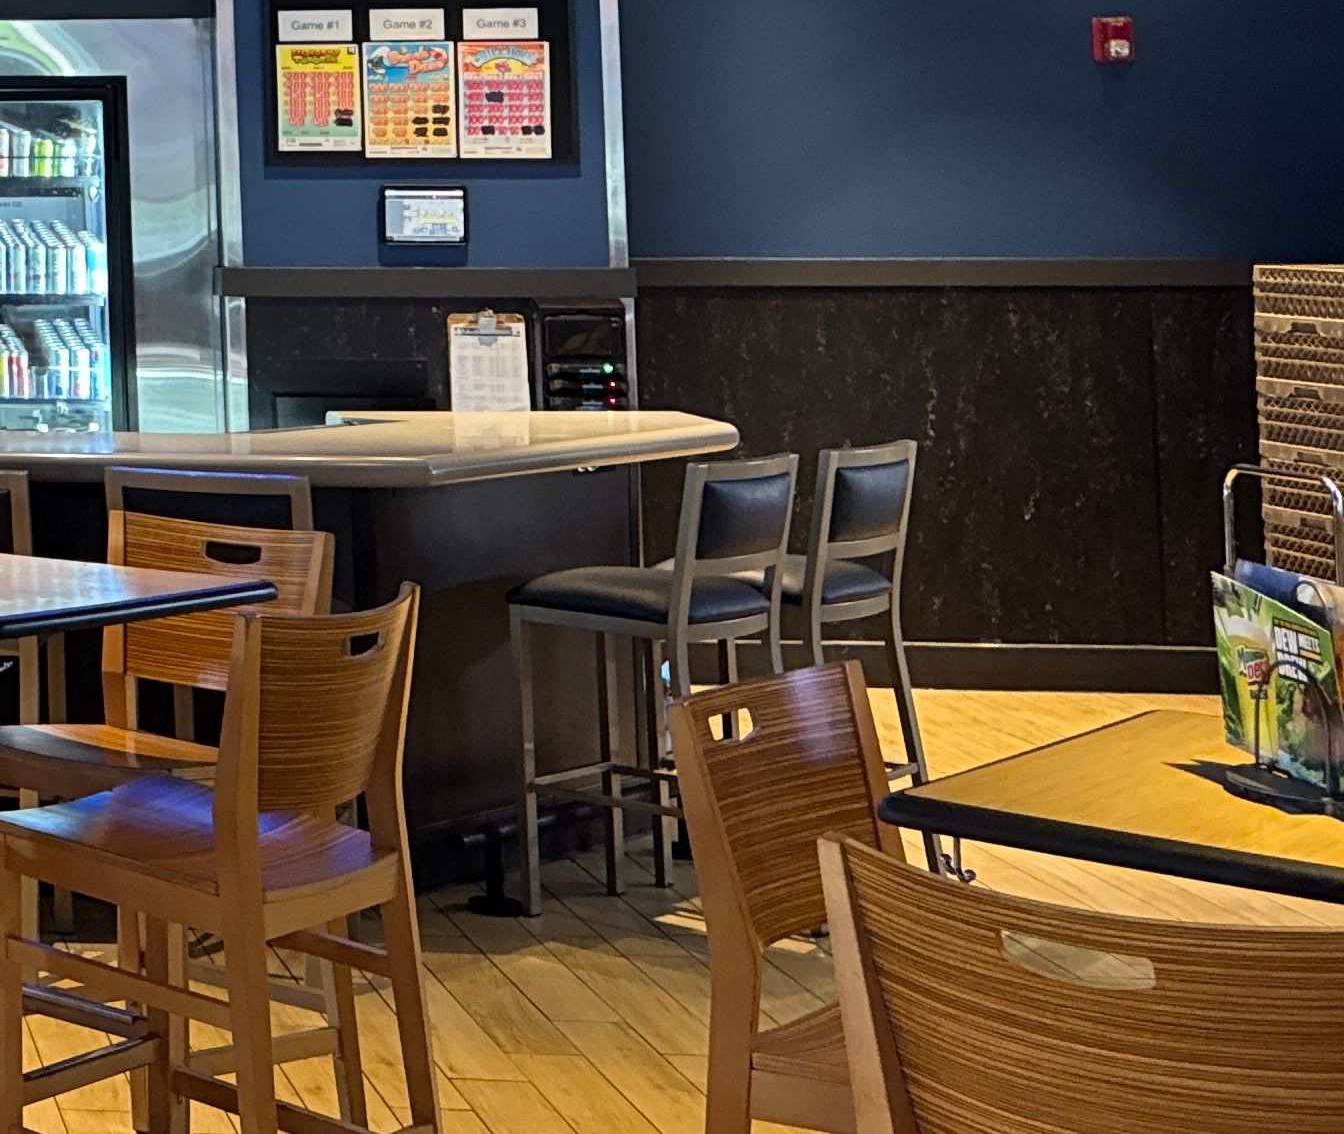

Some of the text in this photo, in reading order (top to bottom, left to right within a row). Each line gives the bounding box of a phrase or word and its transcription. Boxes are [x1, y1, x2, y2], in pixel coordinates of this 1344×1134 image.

[291, 20, 340, 32] Game #1
[383, 18, 432, 30] Game #2
[476, 17, 527, 29] Game #3
